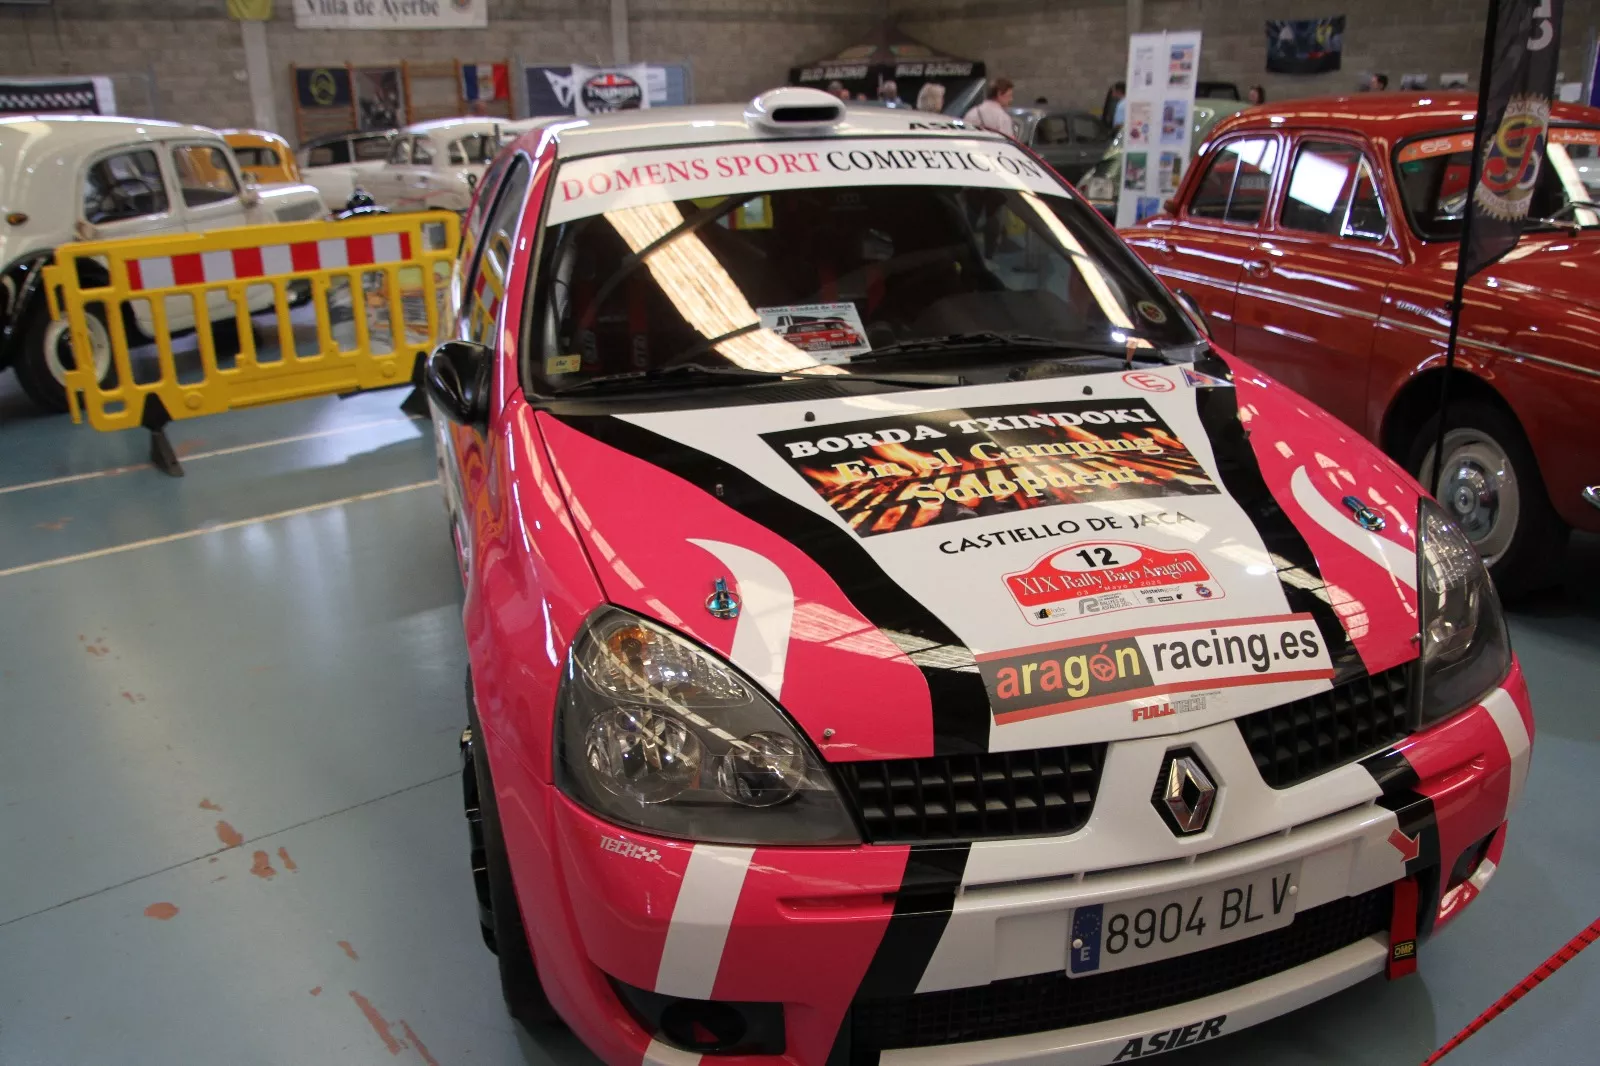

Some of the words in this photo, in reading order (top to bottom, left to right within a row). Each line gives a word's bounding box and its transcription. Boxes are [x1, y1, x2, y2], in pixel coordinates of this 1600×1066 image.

[561, 157, 709, 202] DOMENS
[715, 151, 822, 177] SPORT
[826, 149, 1043, 180] COMPETICIÓN
[786, 421, 946, 459] BORDA
[951, 408, 1157, 438] TXINDOKI
[831, 459, 910, 486] En
[922, 447, 963, 471] el
[969, 435, 1165, 463] Camping
[938, 520, 1081, 555] CASTIELLO
[1087, 516, 1123, 532] DE
[1132, 511, 1196, 530] JACA
[1014, 576, 1061, 596] XIX
[1059, 571, 1104, 590] Rally
[1106, 566, 1141, 585] Bajo
[1142, 556, 1198, 580] Aragón
[1076, 547, 1120, 569] 12
[996, 643, 1141, 699] aragón
[1153, 629, 1320, 673] racing.es
[1105, 896, 1206, 955] 8904
[1219, 873, 1292, 931] BLV
[1080, 946, 1090, 961] E
[1394, 943, 1415, 957] OMP
[1112, 1014, 1228, 1062] ASIER
